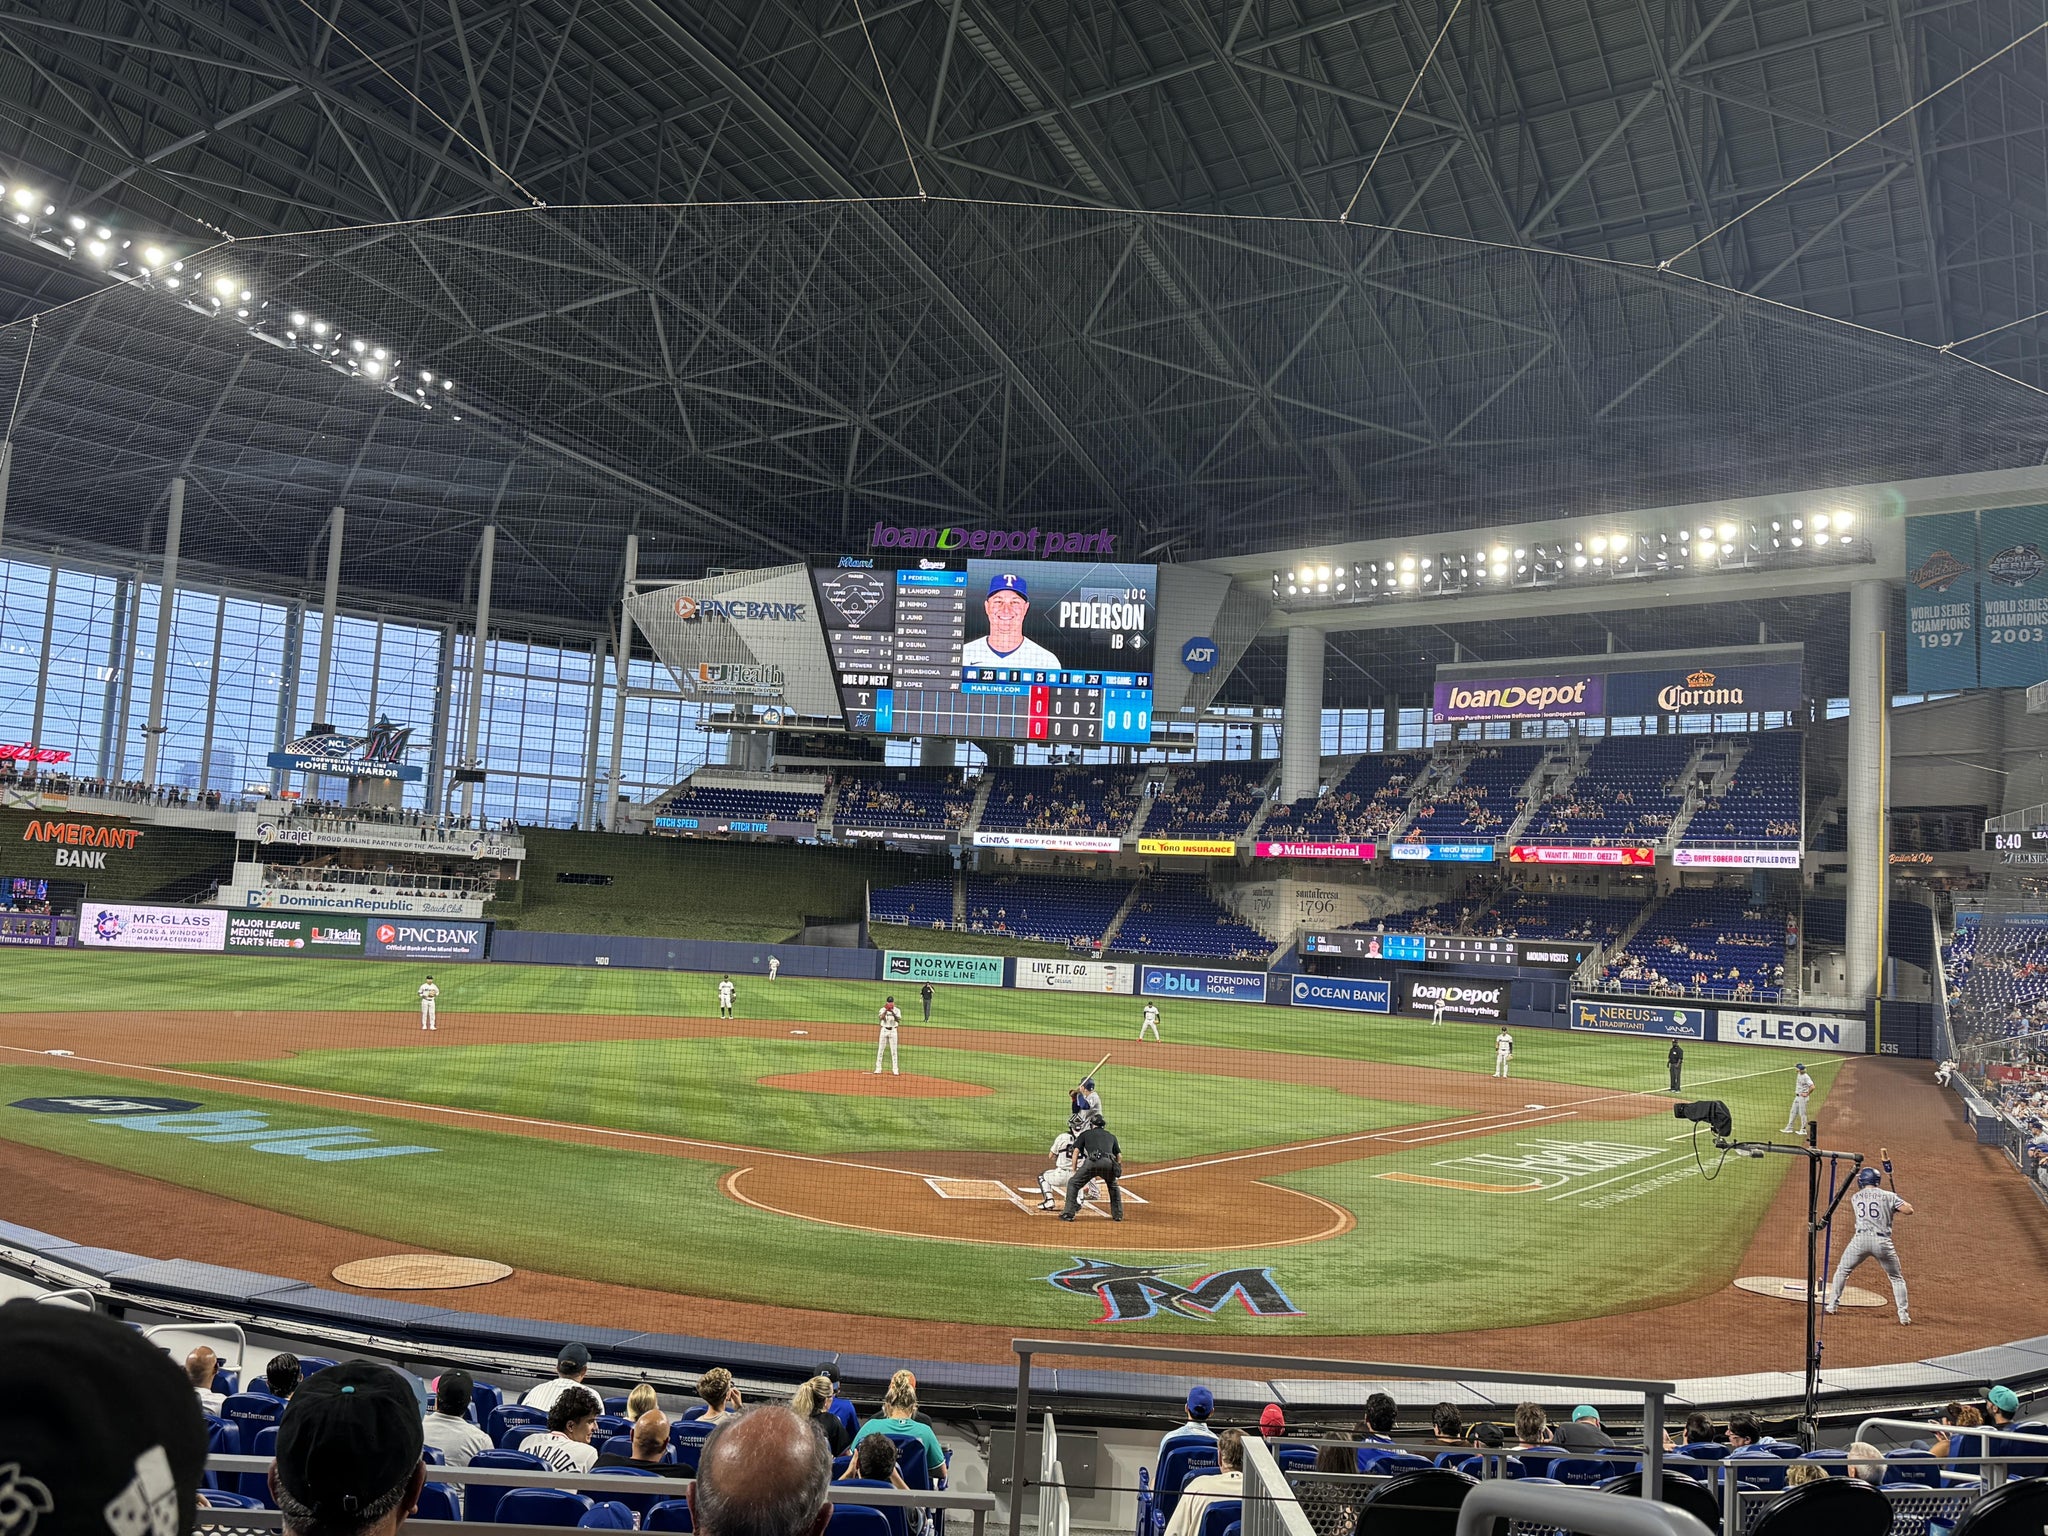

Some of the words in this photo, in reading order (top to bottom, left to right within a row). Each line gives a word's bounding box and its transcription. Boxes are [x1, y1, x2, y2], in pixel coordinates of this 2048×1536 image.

[871, 521, 1041, 557] loanDepot
[1042, 528, 1118, 558] park
[837, 556, 874, 568] Miami
[1996, 554, 2039, 563] WORLD
[1988, 560, 2046, 571] SERIES
[1123, 588, 1147, 600] JOC
[1911, 605, 1940, 620] WORLD
[1941, 603, 1971, 617] SERIES
[1985, 600, 2016, 614] WORLD
[2017, 598, 2048, 613] SERIES
[1059, 601, 1145, 631] PEDERSON
[1985, 612, 2048, 628] CHAMPIONS
[1911, 616, 1971, 634] CHAMPIONS
[1919, 631, 1964, 648] 1997
[1990, 628, 2044, 644] 2003
[1185, 648, 1215, 662] ADT
[842, 674, 857, 685] DUE
[858, 675, 869, 685] UP
[869, 675, 888, 686] NEXT
[1036, 672, 1044, 682] 25
[1087, 674, 1099, 684] .757
[1138, 676, 1148, 686] 0-0
[971, 685, 1021, 694] MARLINS.COM
[1088, 689, 1099, 697] ABS
[1448, 681, 1586, 710] loanDepot
[1657, 684, 1744, 713] Corona
[765, 712, 778, 721] 42
[1543, 710, 1586, 718] loanDepot.com
[328, 739, 347, 749] NCL
[311, 756, 349, 765] NORWEGIAN
[295, 760, 328, 771] HOME
[331, 764, 354, 773] RUN
[357, 766, 398, 778] HARBOR
[655, 817, 676, 828] PITCH
[676, 818, 698, 829] SPEED
[730, 821, 750, 832] PITCH
[751, 822, 768, 832] TYPE
[23, 820, 140, 849] AMERANT
[845, 828, 884, 839] loanDepot
[279, 827, 313, 845] arajet
[343, 836, 371, 844] AIRLINE
[487, 842, 511, 860] arajet
[1157, 842, 1180, 852] TORO
[1995, 833, 2022, 850] 6:40
[1283, 844, 1360, 857] Multinational
[1461, 846, 1486, 854] water
[1544, 851, 1562, 859] WANT
[1572, 851, 1587, 860] NEED
[55, 848, 108, 870] BANK
[1693, 854, 1711, 862] DRIVE
[1712, 855, 1733, 863] SOBER
[1733, 855, 1743, 863] OR
[1743, 855, 1755, 863] GET
[1755, 856, 1779, 864] PULLED
[1780, 856, 1797, 864] OVER
[445, 903, 463, 913] Club
[1254, 897, 1271, 913] 1796
[1299, 899, 1335, 916] 1796
[133, 913, 211, 926] MR-GLASS
[231, 918, 264, 928] MAJOR
[265, 920, 301, 930] LEAGUE
[230, 927, 275, 938] MEDICINE
[311, 927, 361, 941] UHealth
[229, 936, 265, 946] STARTS
[266, 938, 290, 948] HERE
[1317, 936, 1326, 944] CAL
[595, 956, 610, 966] 400
[891, 959, 910, 968] NCL
[1526, 951, 1549, 962] MOUND
[1549, 952, 1569, 963] VISITS
[914, 958, 998, 971] NORWEGIAN
[1032, 962, 1054, 974] LIVE.
[1055, 963, 1072, 975] FIT.
[1073, 965, 1088, 976] GO.
[914, 968, 949, 978] CRUISE
[953, 971, 975, 979] LINE
[1165, 972, 1200, 992] blu
[1206, 974, 1261, 987] DEFENDING
[1206, 984, 1235, 995] HOME
[1310, 986, 1350, 1000] OCEAN
[1353, 989, 1386, 1003] BANK
[1412, 982, 1500, 1006] loanDepot
[1412, 1001, 1434, 1011] Home
[1459, 1005, 1500, 1018] Everything
[1600, 1006, 1650, 1022] NEREUS
[1664, 1025, 1696, 1034] VANDA
[1761, 1019, 1840, 1044] LEON
[1880, 1042, 1899, 1054] 335
[1856, 1201, 1880, 1219] 36
